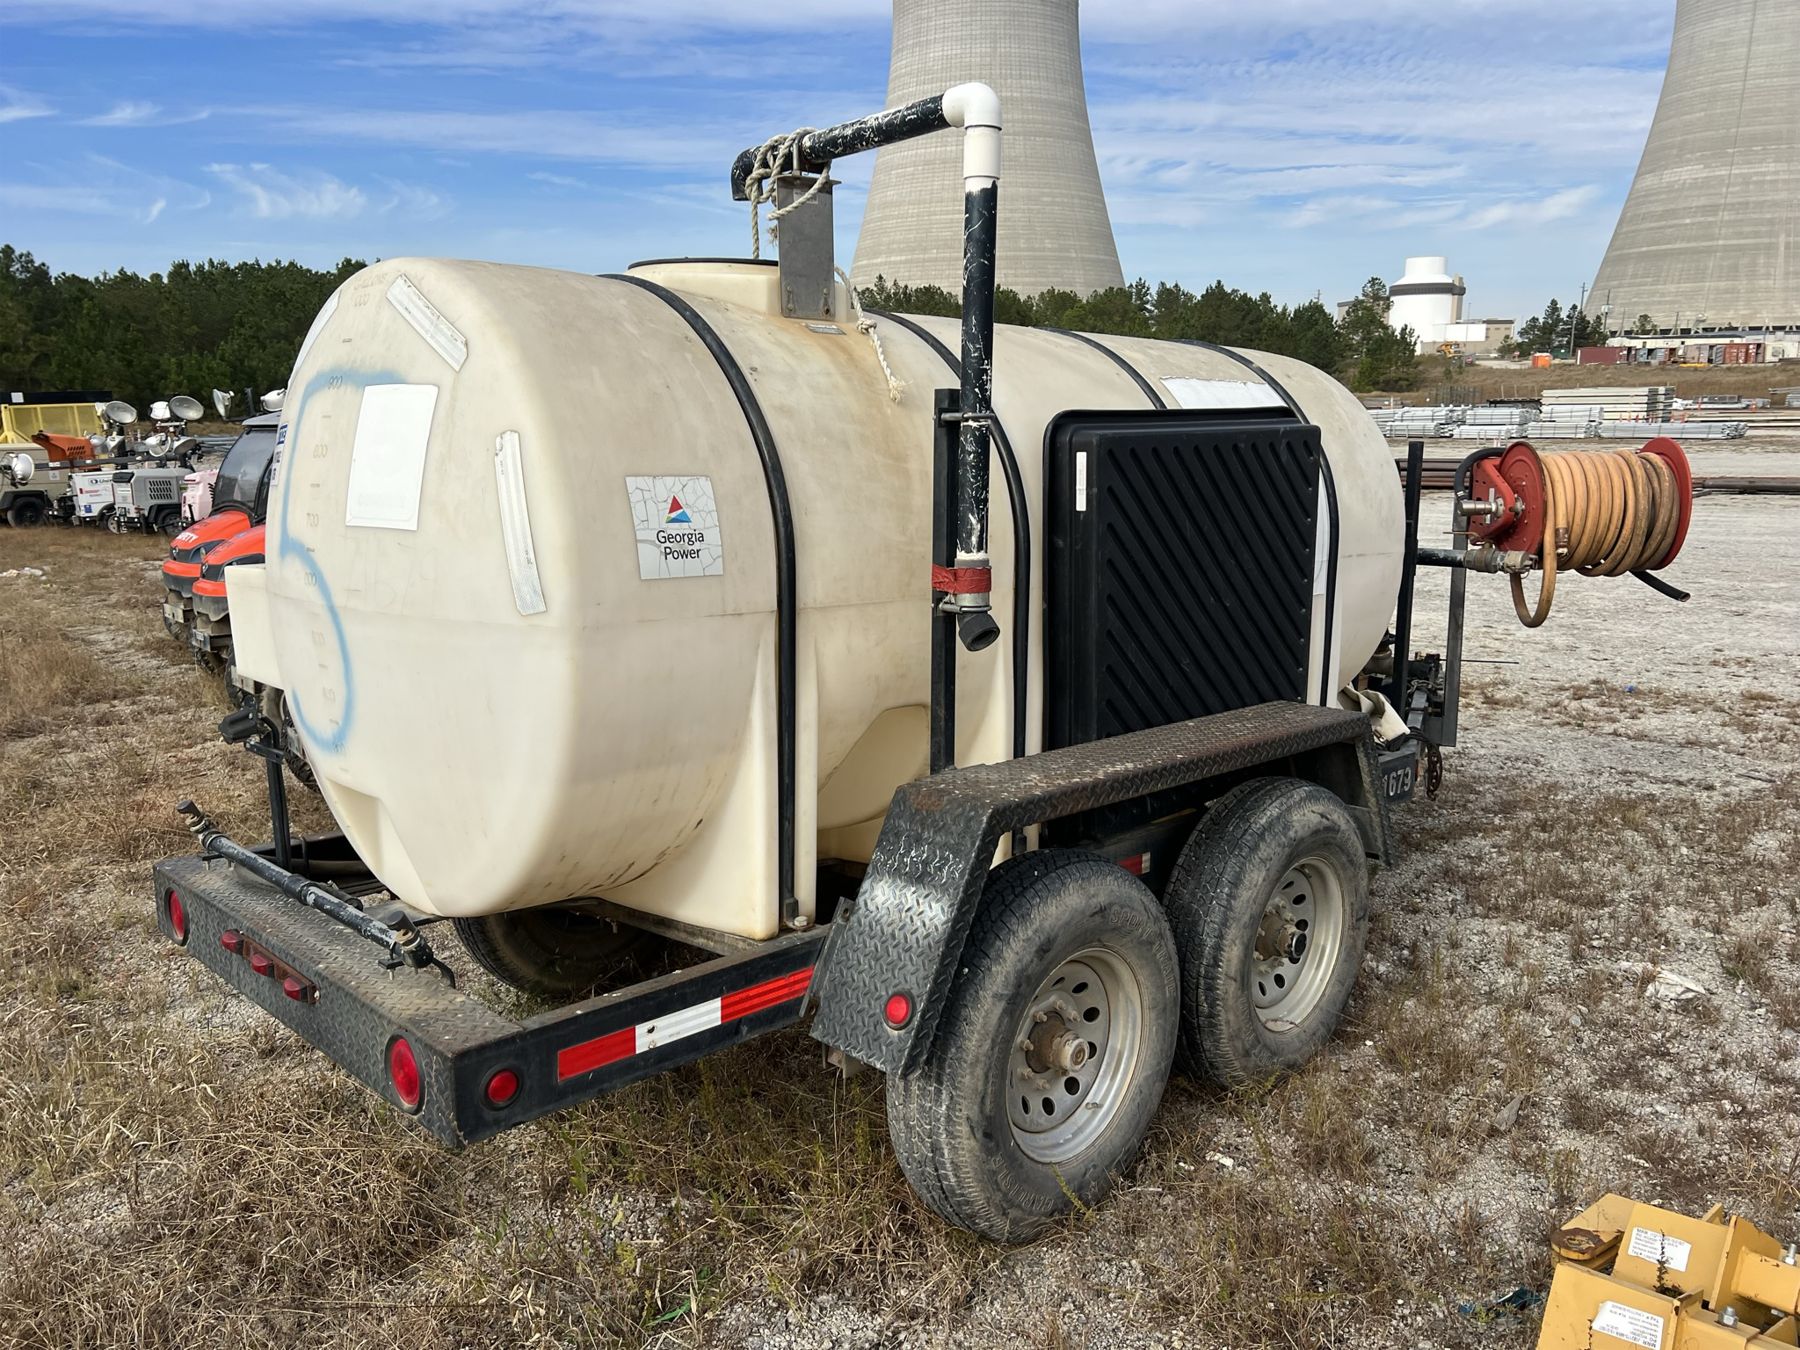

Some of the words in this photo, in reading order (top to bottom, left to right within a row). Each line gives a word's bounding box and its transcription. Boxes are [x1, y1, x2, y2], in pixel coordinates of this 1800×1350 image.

[656, 529, 704, 546] Georgia
[663, 546, 701, 560] Power
[991, 1151, 1055, 1212] CARLISLE
